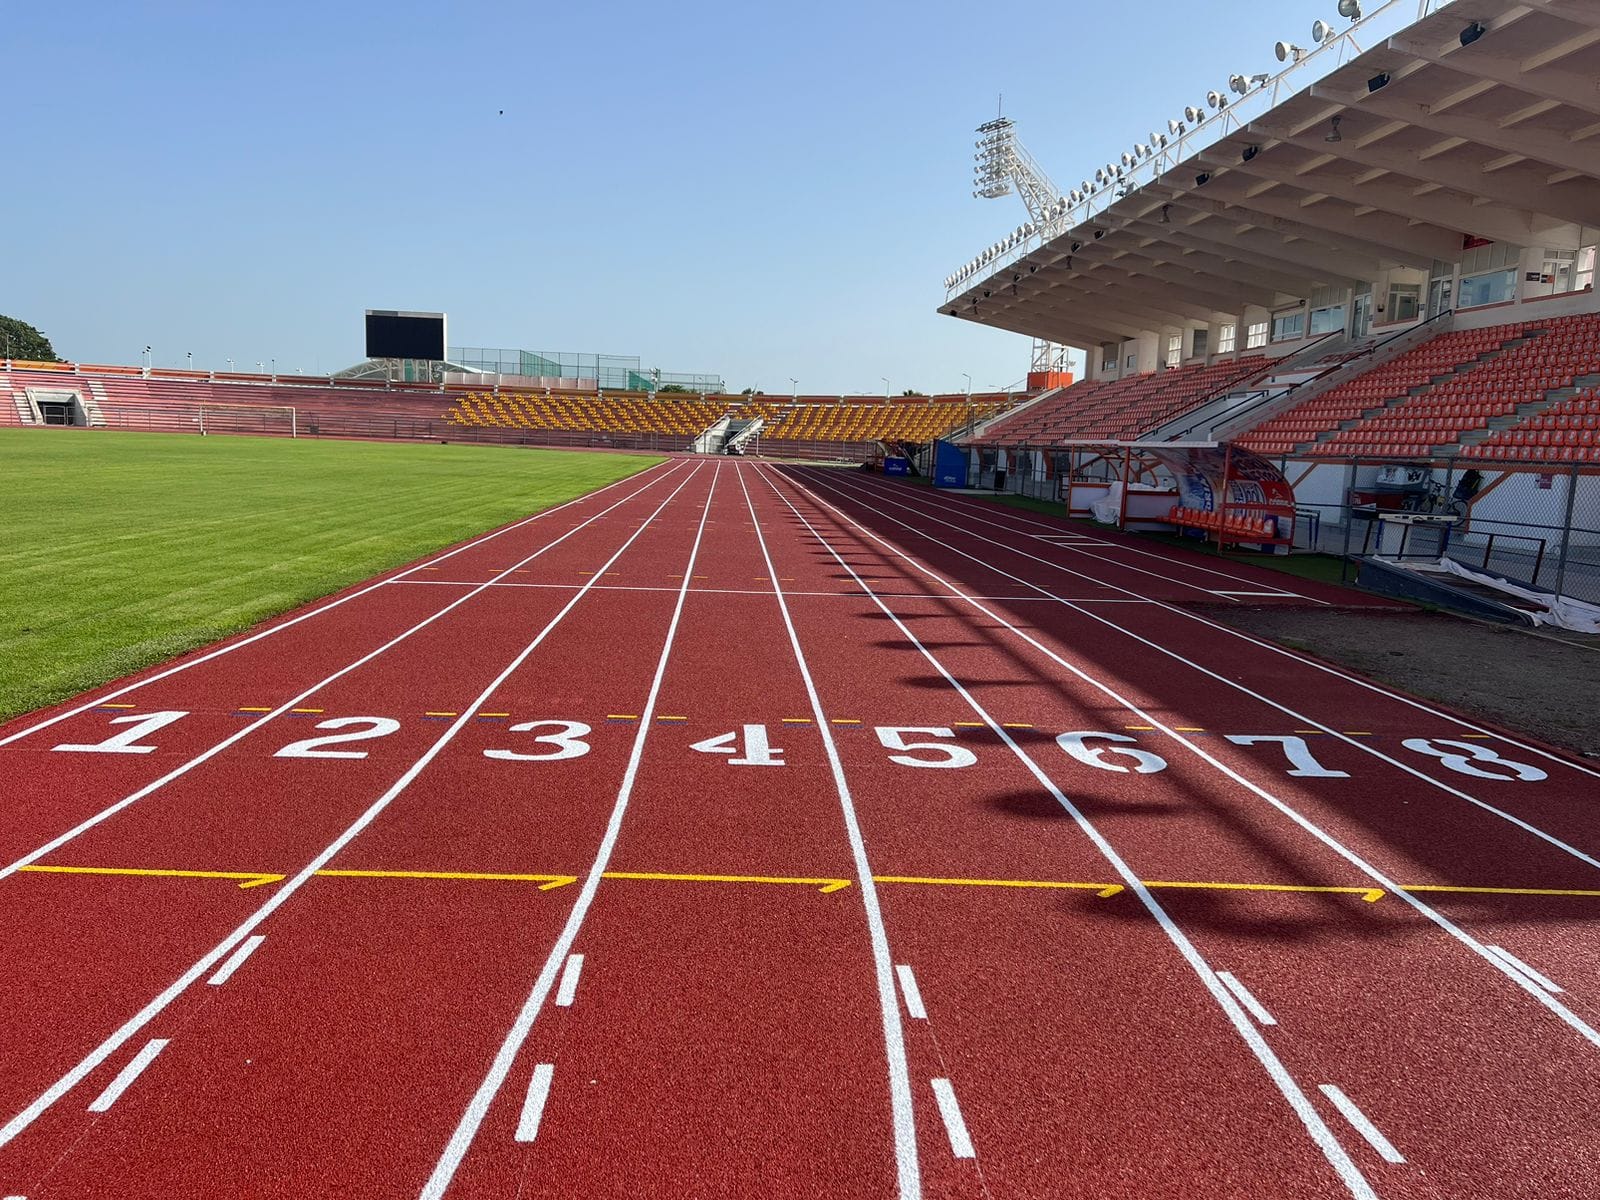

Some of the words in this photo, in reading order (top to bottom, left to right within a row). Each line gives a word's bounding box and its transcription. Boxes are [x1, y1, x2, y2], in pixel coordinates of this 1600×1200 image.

[50, 711, 190, 753] 1
[273, 716, 400, 759] 2
[483, 720, 591, 761] 3
[689, 724, 785, 766] 4
[874, 727, 978, 769] 5
[1056, 731, 1167, 773] 6
[1224, 735, 1350, 777] 7
[1402, 739, 1547, 781] 8
